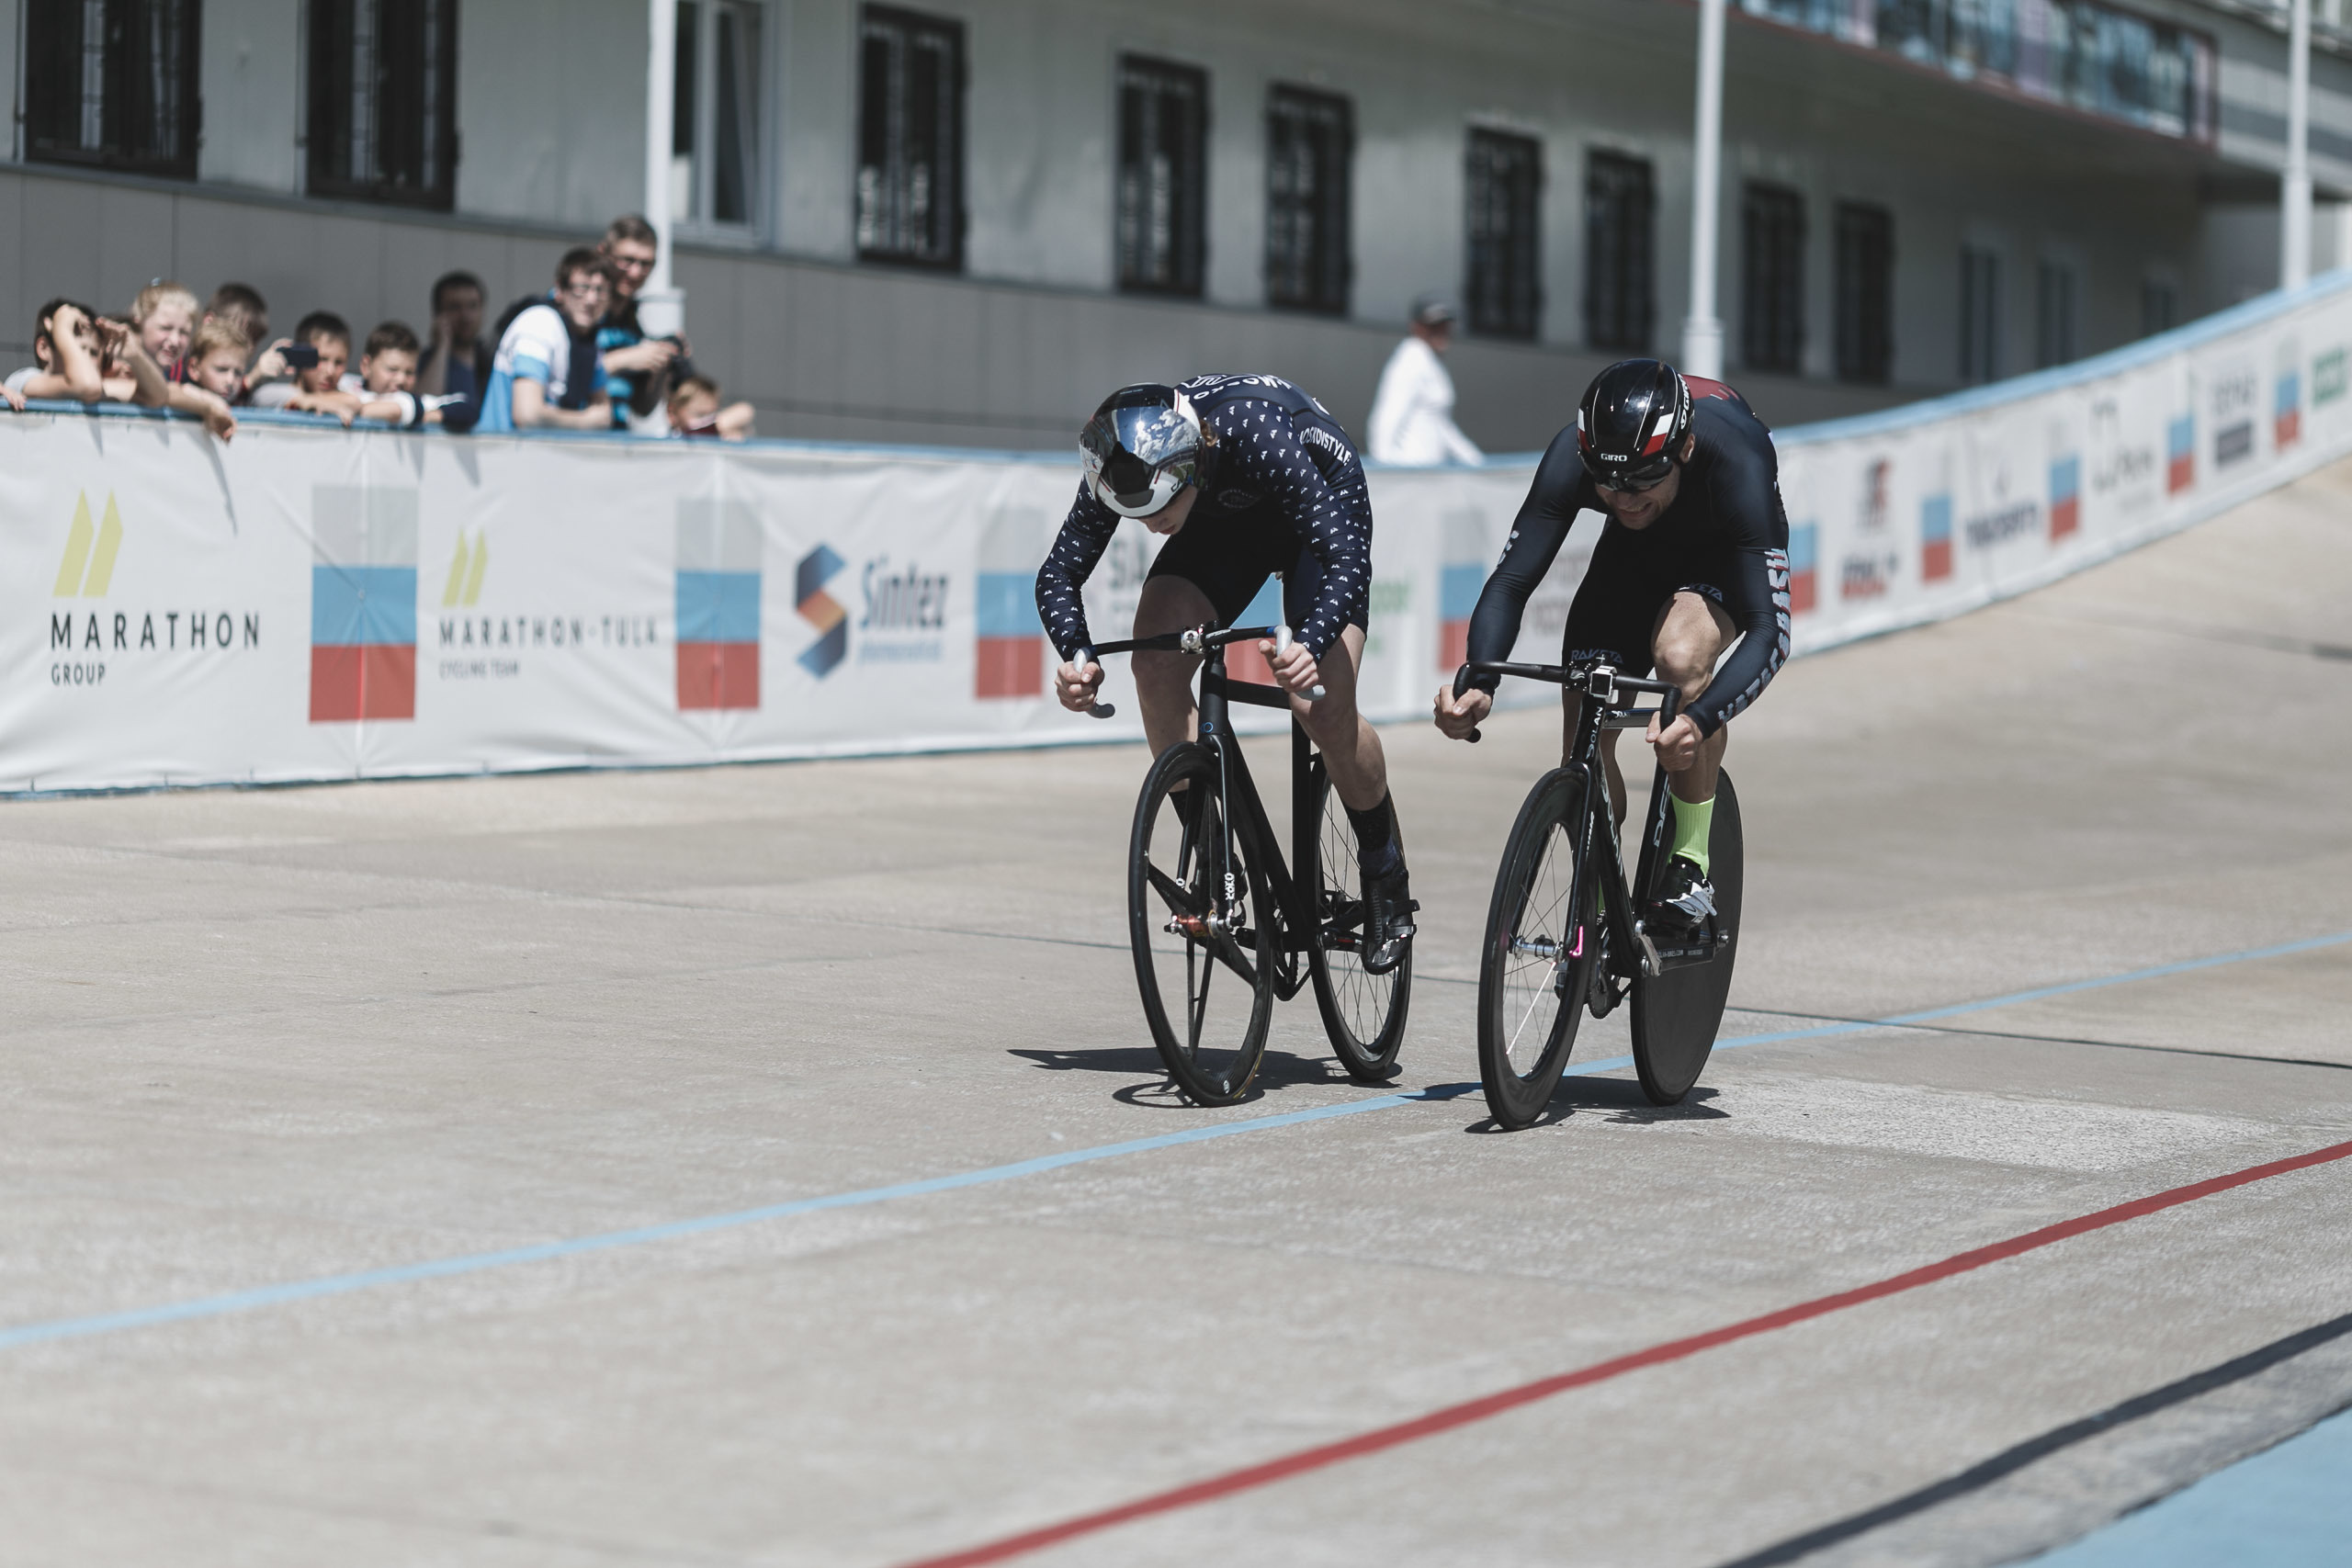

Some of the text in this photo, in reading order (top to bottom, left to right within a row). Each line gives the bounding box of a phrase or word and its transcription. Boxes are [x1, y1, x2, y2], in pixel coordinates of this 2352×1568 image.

[1600, 453, 1628, 462] GIRO
[51, 611, 259, 651] MARATHON
[51, 661, 106, 686] GROUP
